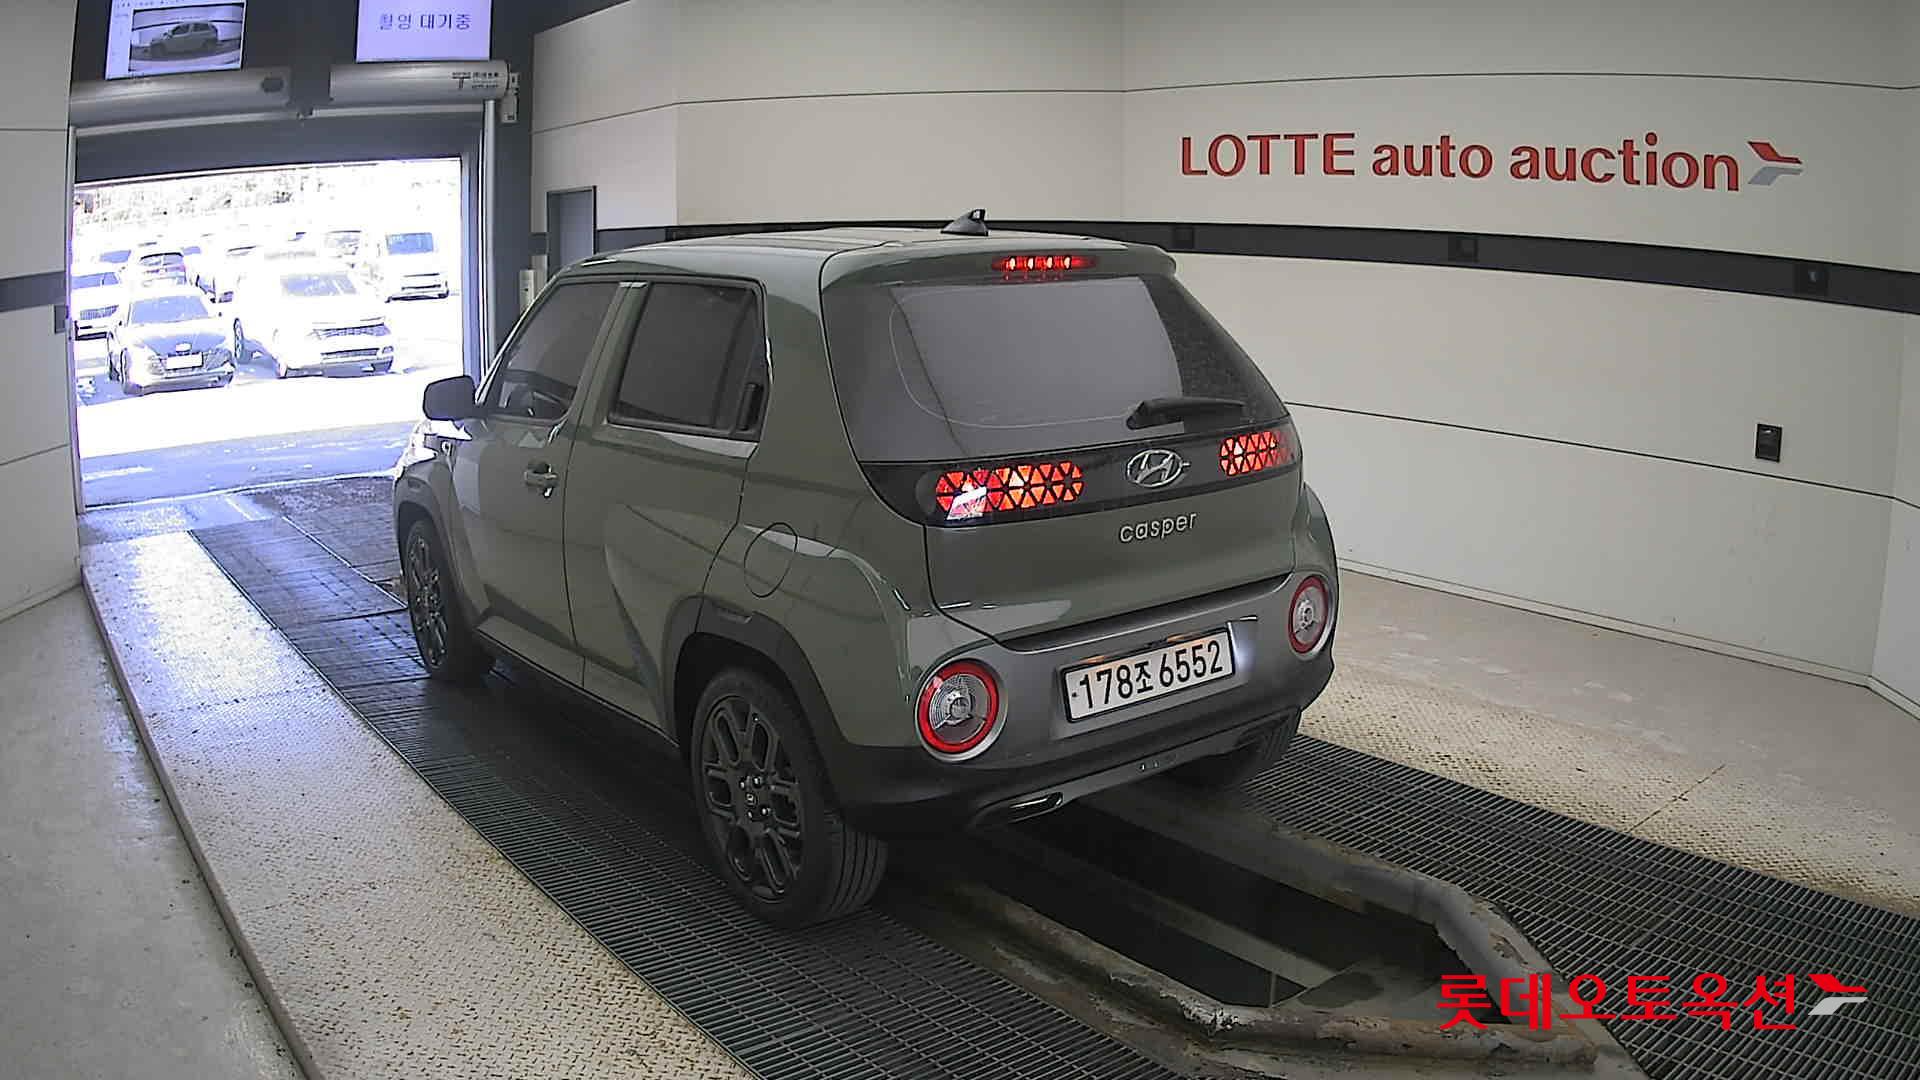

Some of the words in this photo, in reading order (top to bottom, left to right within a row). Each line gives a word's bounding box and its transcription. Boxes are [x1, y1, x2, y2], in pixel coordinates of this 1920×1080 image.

[420, 13, 471, 31] 대기중
[1181, 132, 1356, 178] LOTTE
[1372, 134, 1494, 179] auto
[1509, 132, 1740, 192] auction
[1119, 512, 1197, 543] casper
[1079, 661, 1154, 709] 178조
[1159, 640, 1224, 688] 6552
